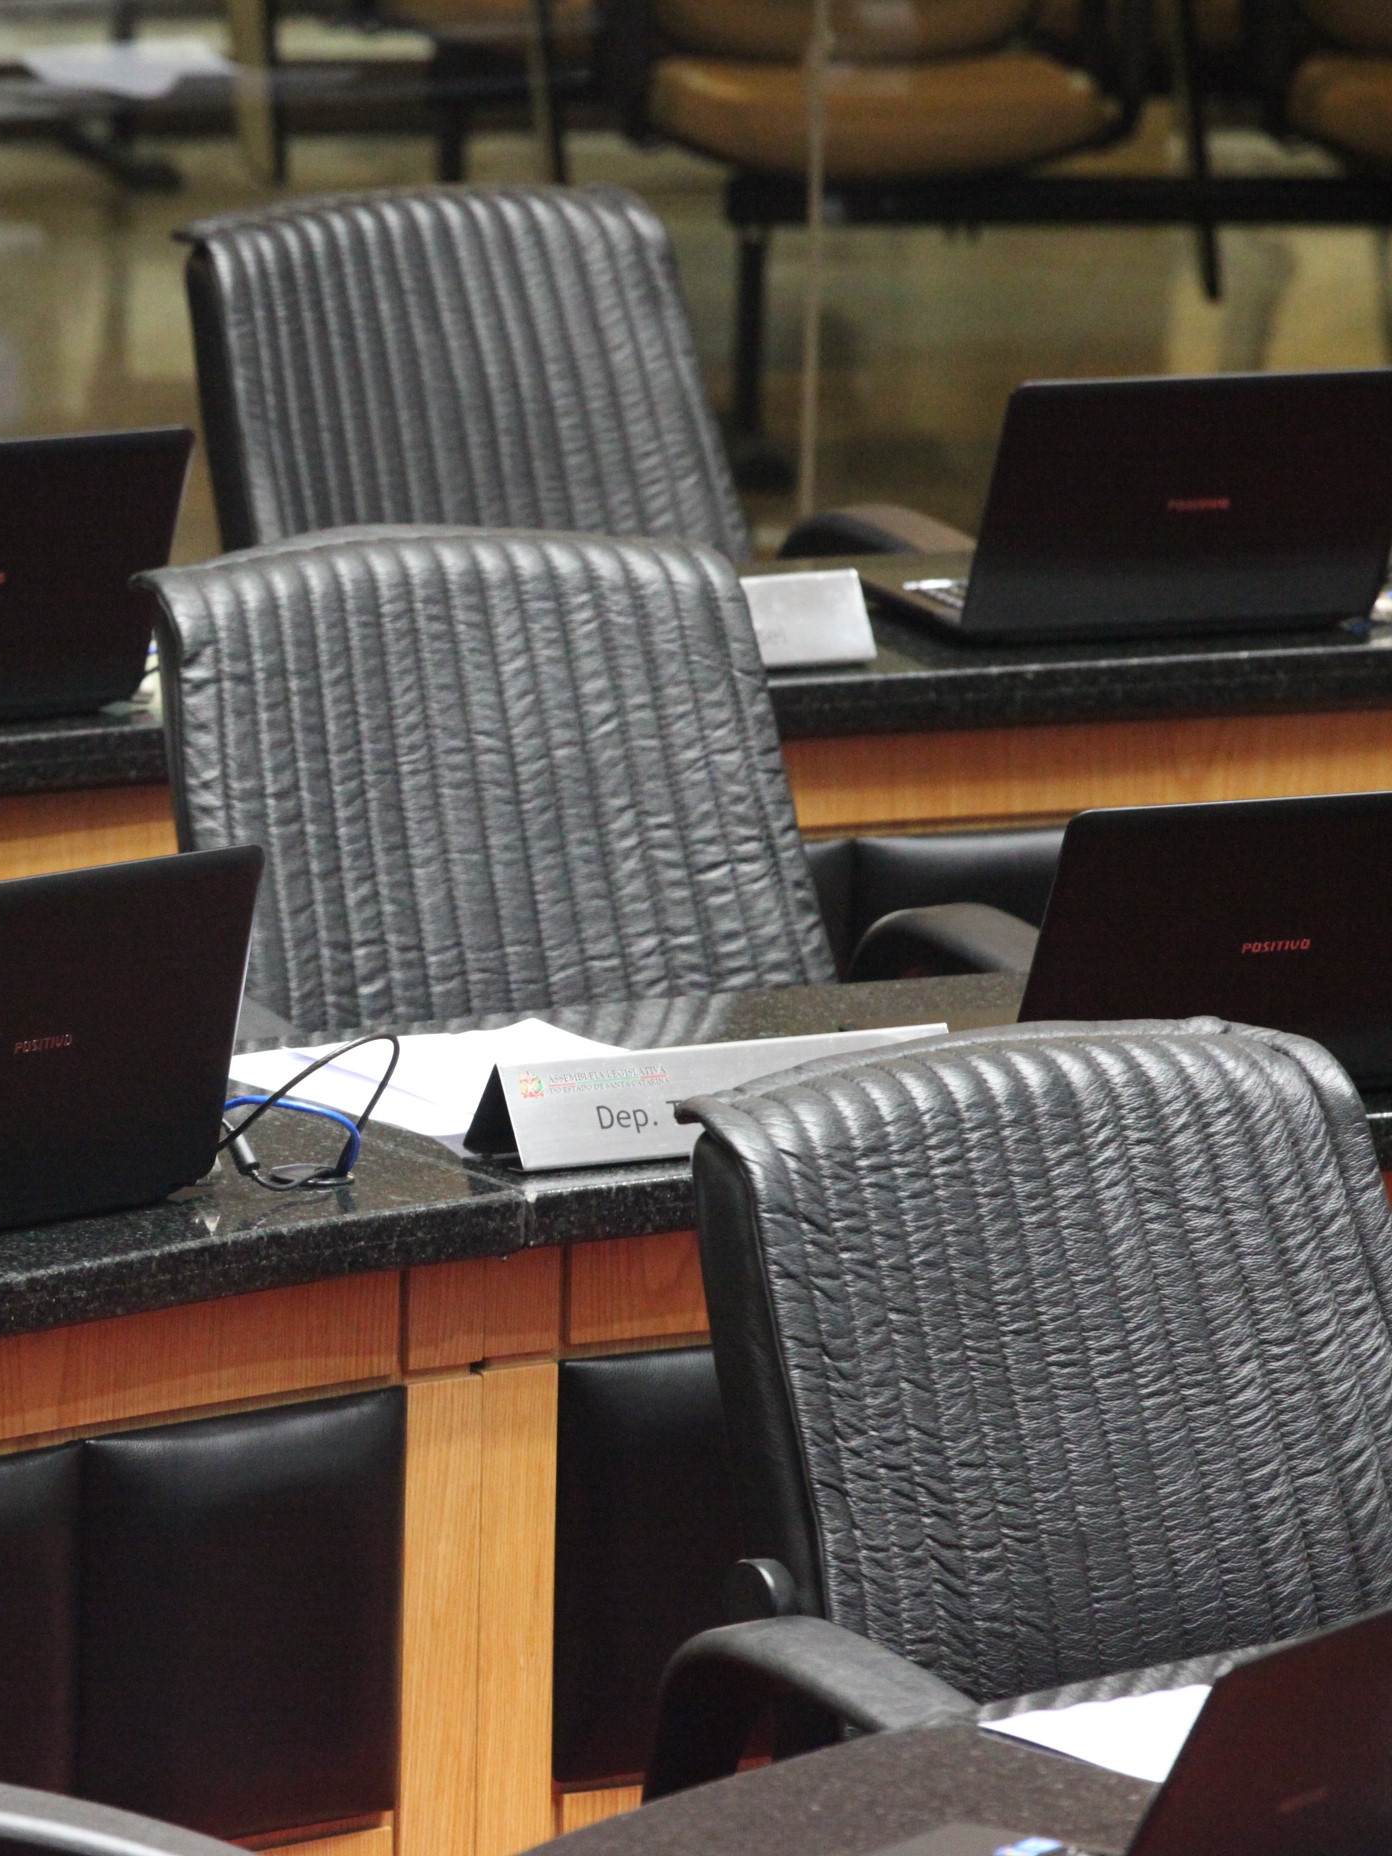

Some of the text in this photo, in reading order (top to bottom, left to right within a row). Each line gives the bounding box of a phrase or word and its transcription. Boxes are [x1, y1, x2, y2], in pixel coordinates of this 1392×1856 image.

[1241, 938, 1311, 954] POSITIVO
[14, 1033, 73, 1055] POSITIVO
[596, 1105, 658, 1134] Dep.
